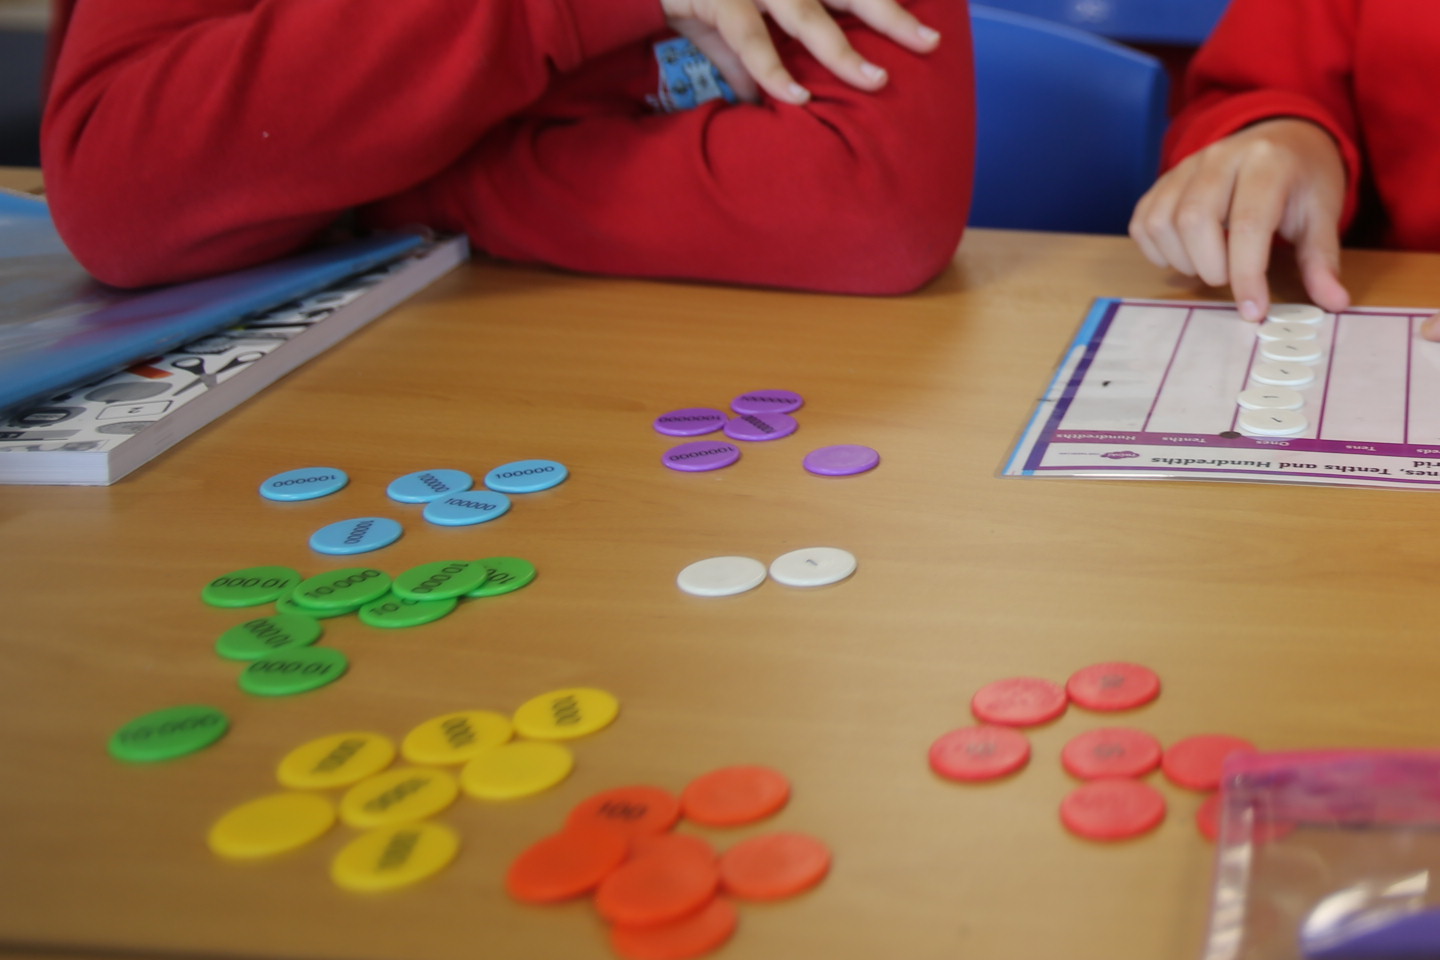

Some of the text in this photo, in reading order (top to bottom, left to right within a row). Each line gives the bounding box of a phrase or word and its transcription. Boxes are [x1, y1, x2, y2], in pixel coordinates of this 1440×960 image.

[1056, 433, 1137, 442] Hundredths
[1161, 436, 1206, 444] Tenths
[1255, 440, 1291, 448] Ones
[1345, 444, 1377, 452] Tens
[1151, 456, 1272, 469] Hundredths
[1278, 461, 1318, 470] and
[494, 465, 556, 480] 100000
[1323, 464, 1392, 476] Tenths
[271, 473, 337, 488] 100000
[444, 497, 497, 512] 100000
